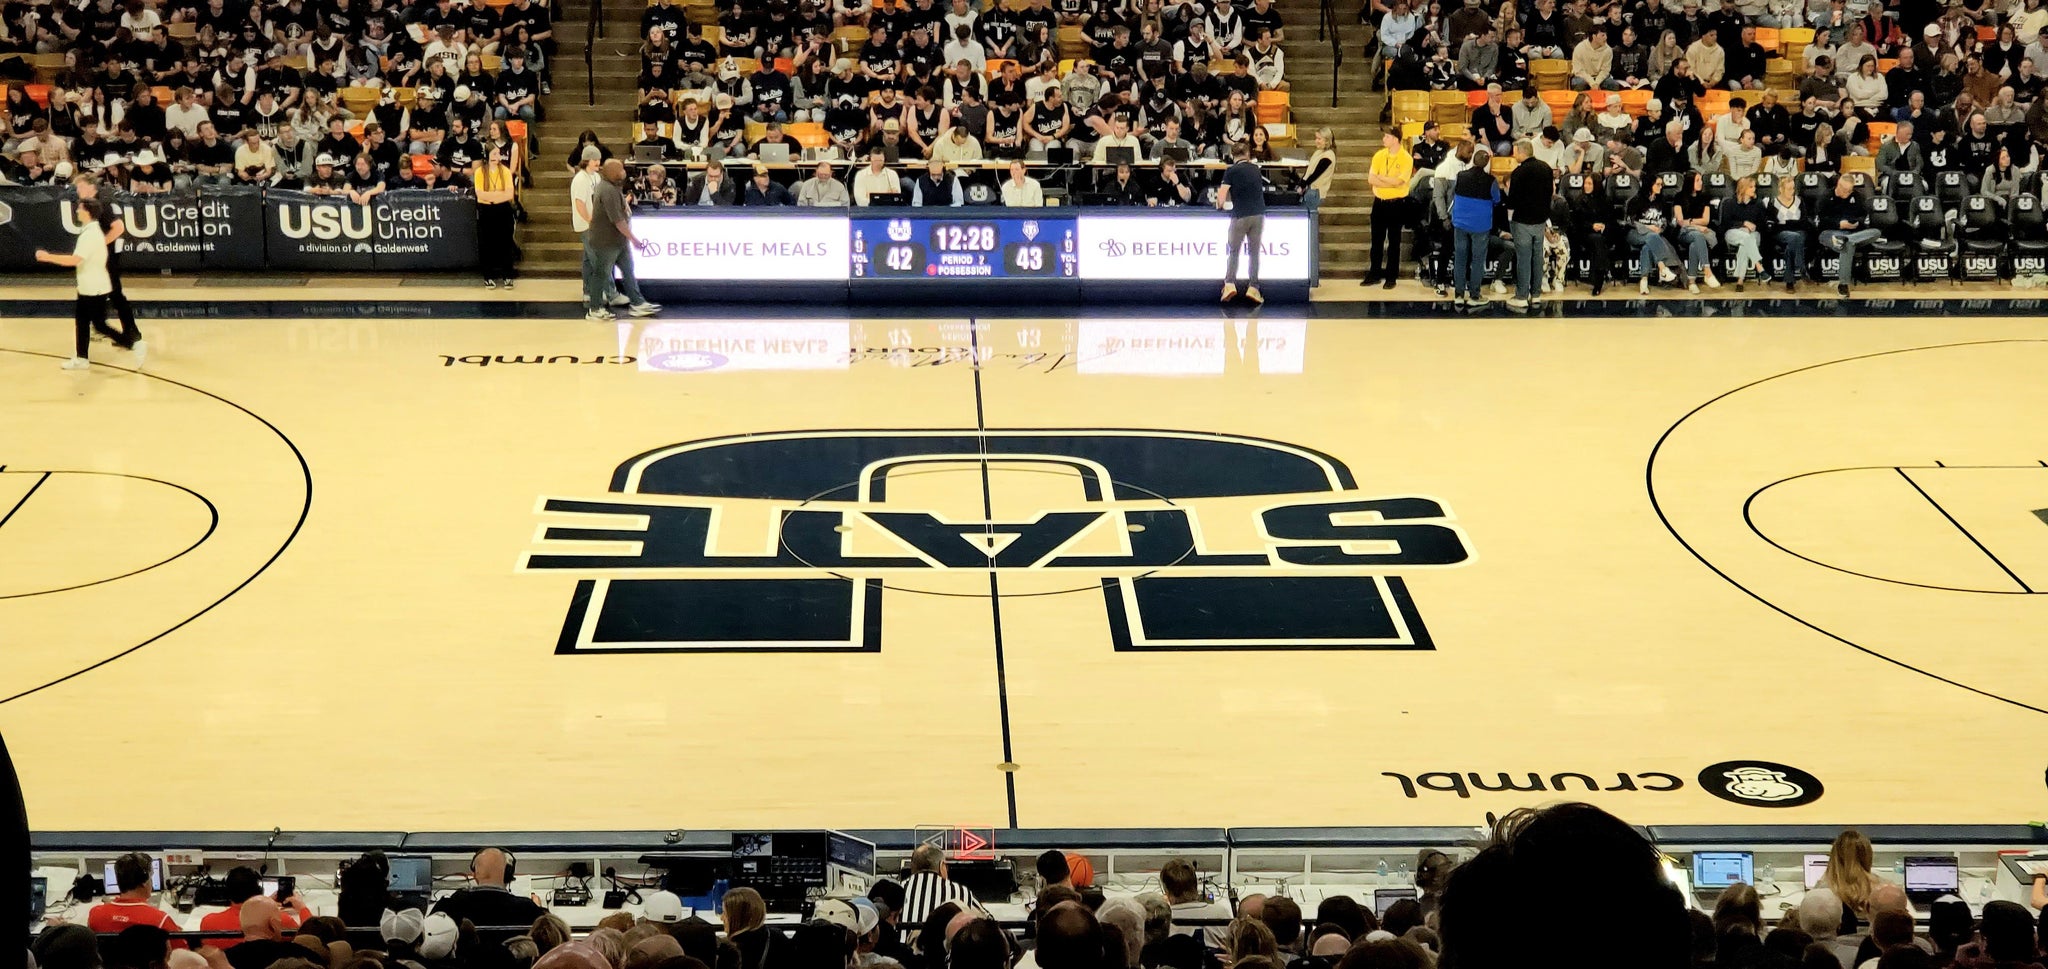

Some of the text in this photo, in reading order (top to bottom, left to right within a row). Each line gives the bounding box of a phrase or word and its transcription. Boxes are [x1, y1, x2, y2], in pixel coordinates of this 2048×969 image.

[377, 204, 440, 222] Credit
[279, 204, 373, 240] USU
[162, 220, 231, 238] Union
[378, 222, 443, 239] Union
[936, 226, 995, 251] 12:28
[306, 243, 341, 252] division
[342, 243, 351, 252] of
[374, 243, 429, 253] Goldenwest
[667, 242, 827, 256] BEEHIVE MEALS
[1132, 242, 1218, 256] BEEHIVE
[852, 255, 868, 263] TOL
[887, 247, 913, 271] 42
[941, 255, 973, 265] PERIOD
[1016, 247, 1043, 270] 43
[1060, 254, 1077, 263] TOL
[1869, 259, 1900, 270] USU
[1918, 259, 1948, 270] USU
[1966, 258, 1996, 270] USU
[2014, 258, 2045, 270] USU
[855, 264, 863, 276] 3
[938, 265, 992, 276] POSSESSION
[1065, 264, 1073, 276] 3
[439, 355, 637, 367] crumbl
[514, 494, 1478, 572] STATE
[1382, 772, 1684, 798] crumbl
